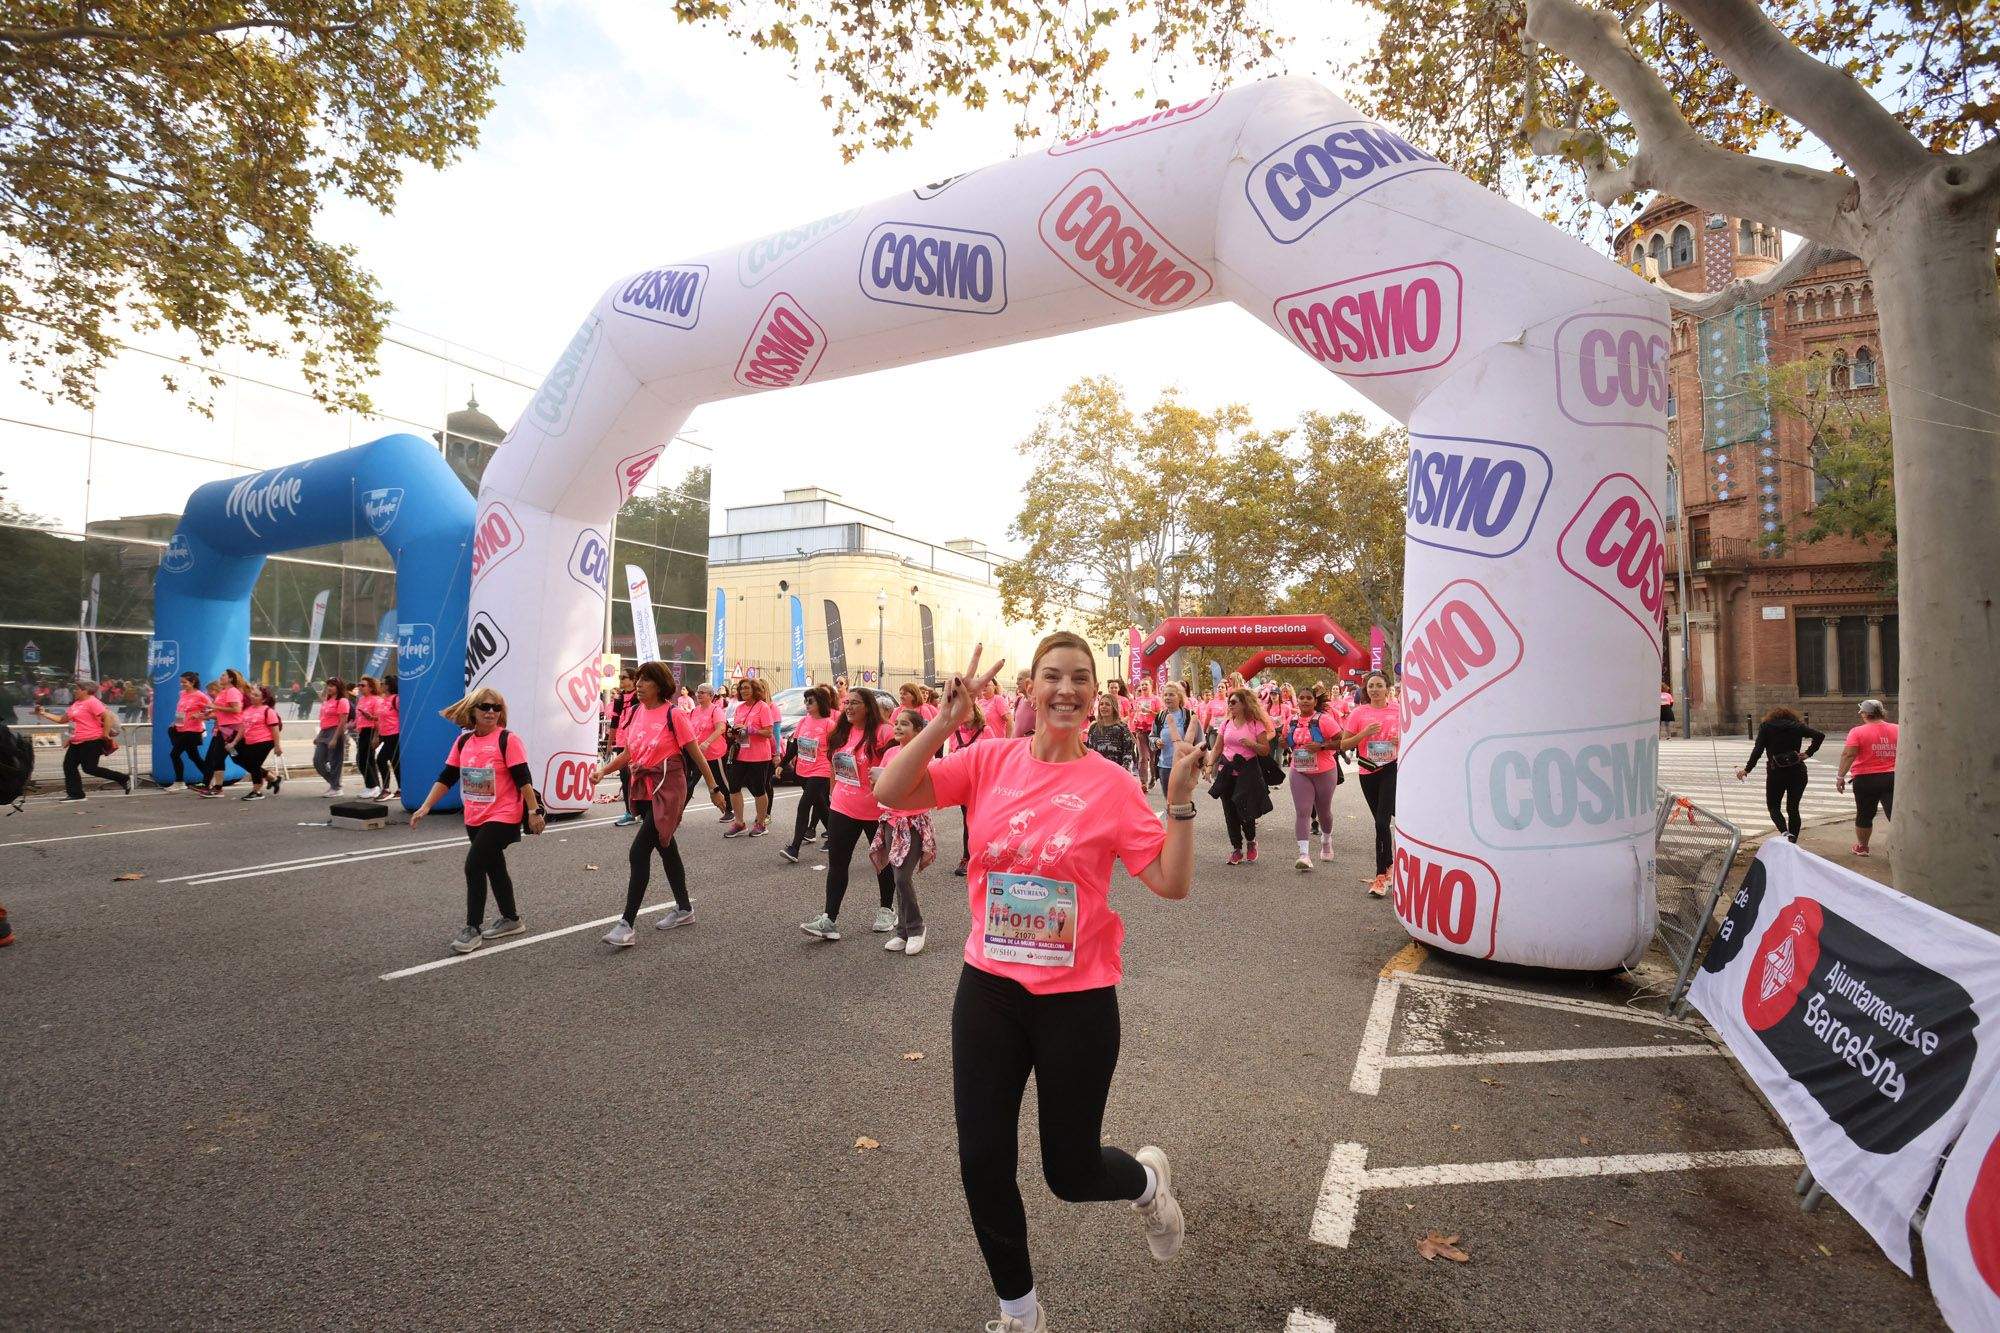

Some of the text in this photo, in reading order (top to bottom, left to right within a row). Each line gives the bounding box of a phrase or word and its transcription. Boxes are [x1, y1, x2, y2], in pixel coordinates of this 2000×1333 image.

[871, 232, 993, 303] COSMO
[1055, 185, 1196, 306] COSMO
[622, 270, 699, 317] COSMO
[1287, 277, 1441, 363] COSMO
[744, 306, 815, 387] COSMO
[1579, 328, 1669, 412] COS
[225, 465, 302, 538] Marlene
[580, 538, 608, 592] CO
[1179, 624, 1306, 635] Ajuntament de Barcelona
[1265, 654, 1326, 664] elPeriódico
[1880, 736, 1889, 744] TU
[1012, 886, 1047, 897] ASTURIANA
[1393, 846, 1477, 945] SMO
[990, 947, 1064, 961] OYSHO Santander
[1015, 931, 1036, 940] 21070
